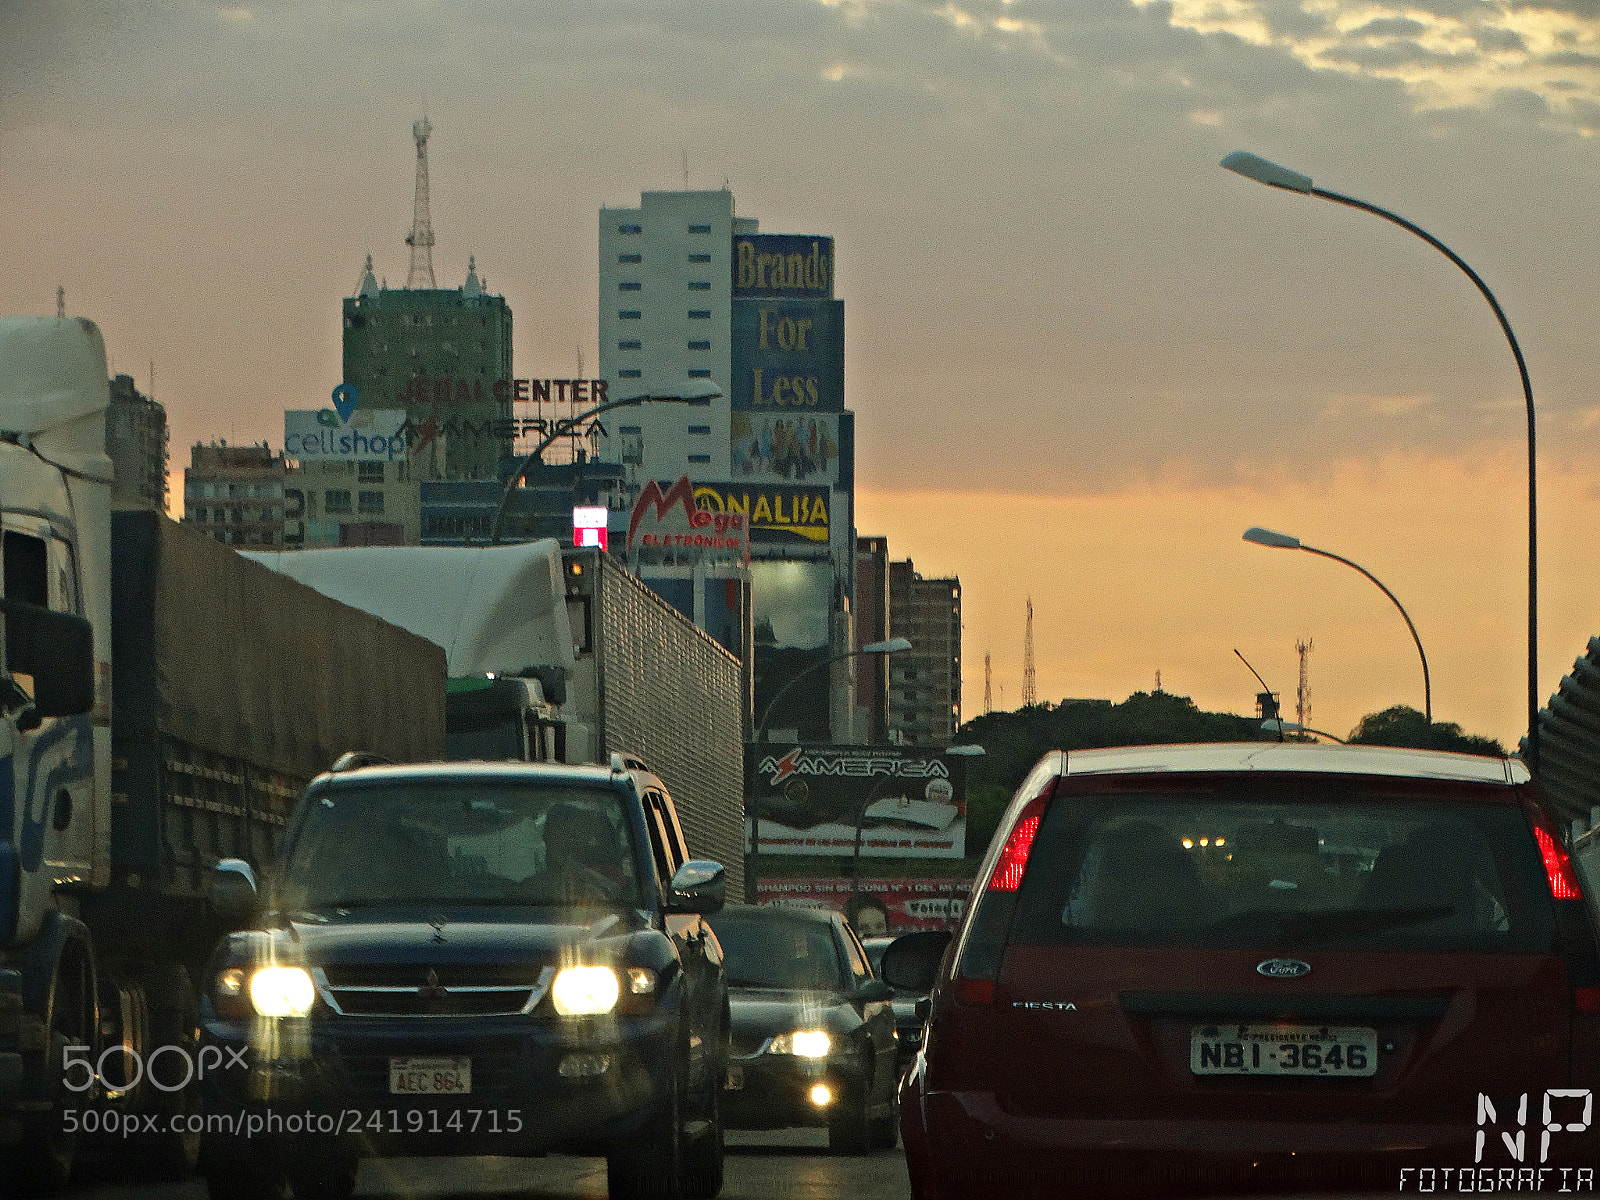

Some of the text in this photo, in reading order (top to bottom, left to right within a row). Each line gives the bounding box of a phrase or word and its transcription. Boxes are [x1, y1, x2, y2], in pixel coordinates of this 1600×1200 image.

[736, 241, 829, 290] Brands
[757, 307, 813, 350] For
[492, 378, 609, 403] CENTER
[752, 368, 819, 406] Less
[284, 429, 405, 460] cellshop
[815, 883, 834, 893] SIN
[1012, 1001, 1078, 1012] FIESTA
[396, 1071, 465, 1092] AEC 864
